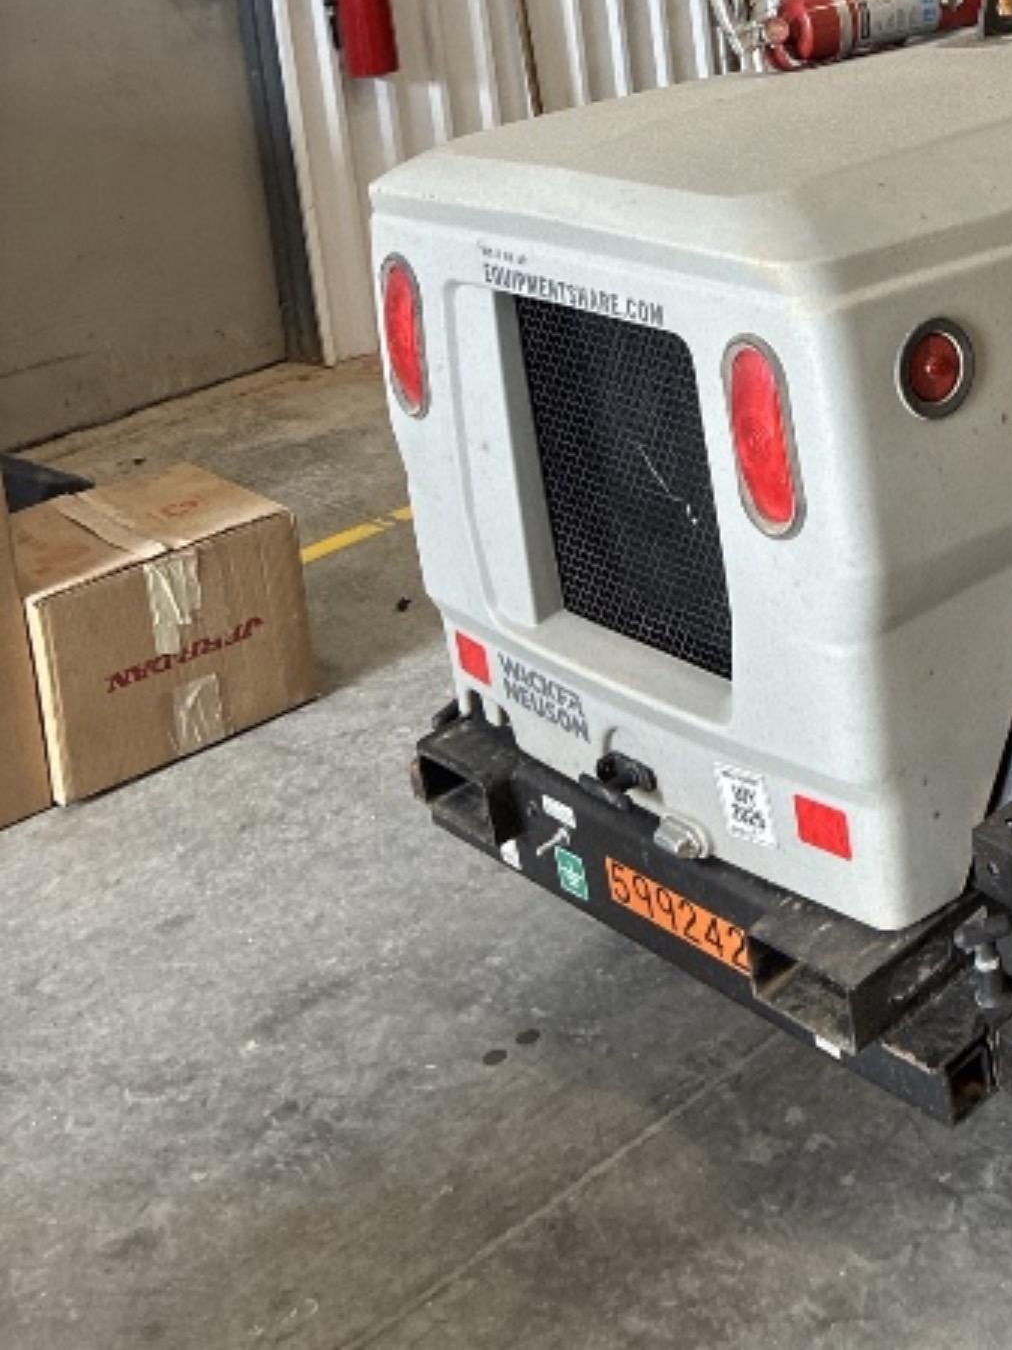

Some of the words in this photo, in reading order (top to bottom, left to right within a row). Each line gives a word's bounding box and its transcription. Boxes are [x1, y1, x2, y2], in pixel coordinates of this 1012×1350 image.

[483, 262, 664, 327] EQUIPMENTSHARE.COM
[497, 651, 583, 715] WACKER
[503, 677, 591, 745] NEUSON
[611, 863, 750, 971] 599242
